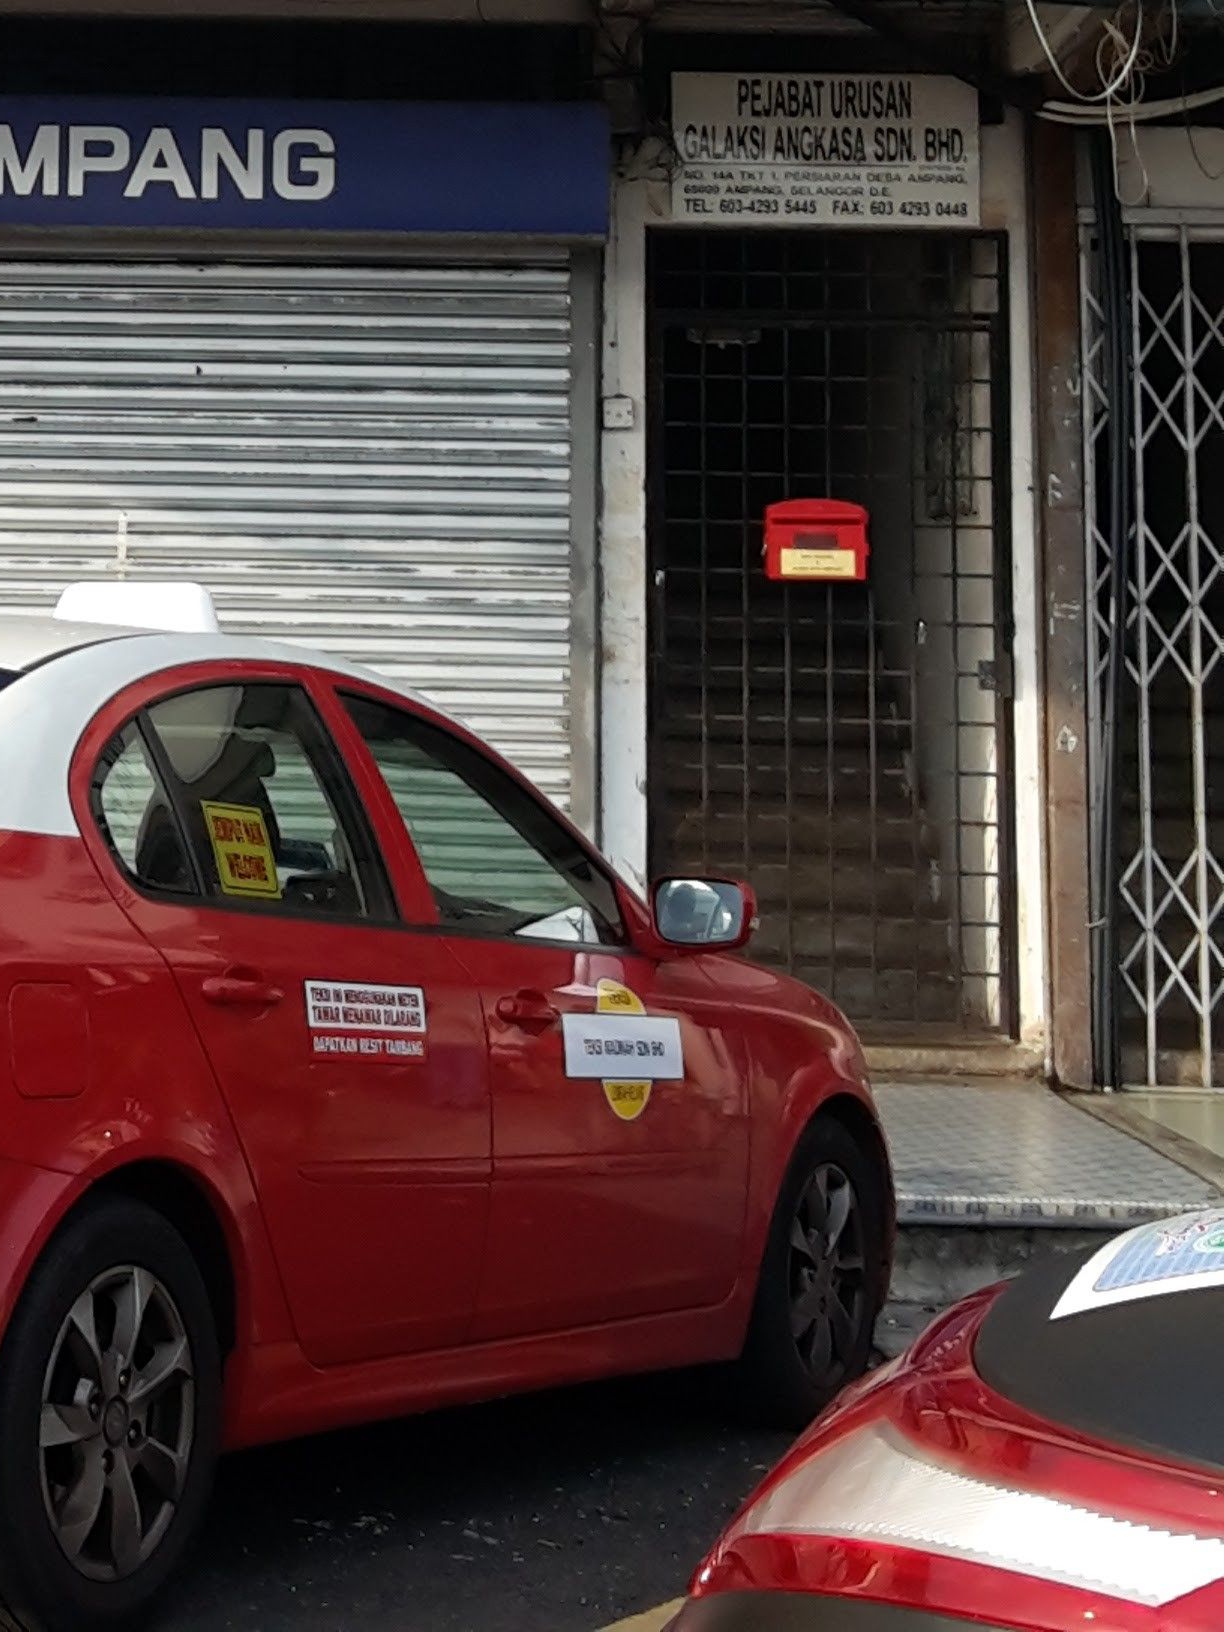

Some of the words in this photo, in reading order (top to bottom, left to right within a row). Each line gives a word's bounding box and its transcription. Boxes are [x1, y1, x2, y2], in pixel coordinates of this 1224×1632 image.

[737, 79, 824, 118] PEJABAT
[830, 80, 913, 119] URUSAN
[683, 124, 766, 160] GALAKSI
[773, 125, 866, 161] ANGKASA
[873, 126, 917, 161] SDN.
[924, 127, 968, 163] BHD.
[684, 199, 714, 214] TEL:
[832, 201, 865, 215] FAX:
[870, 201, 893, 216] 603
